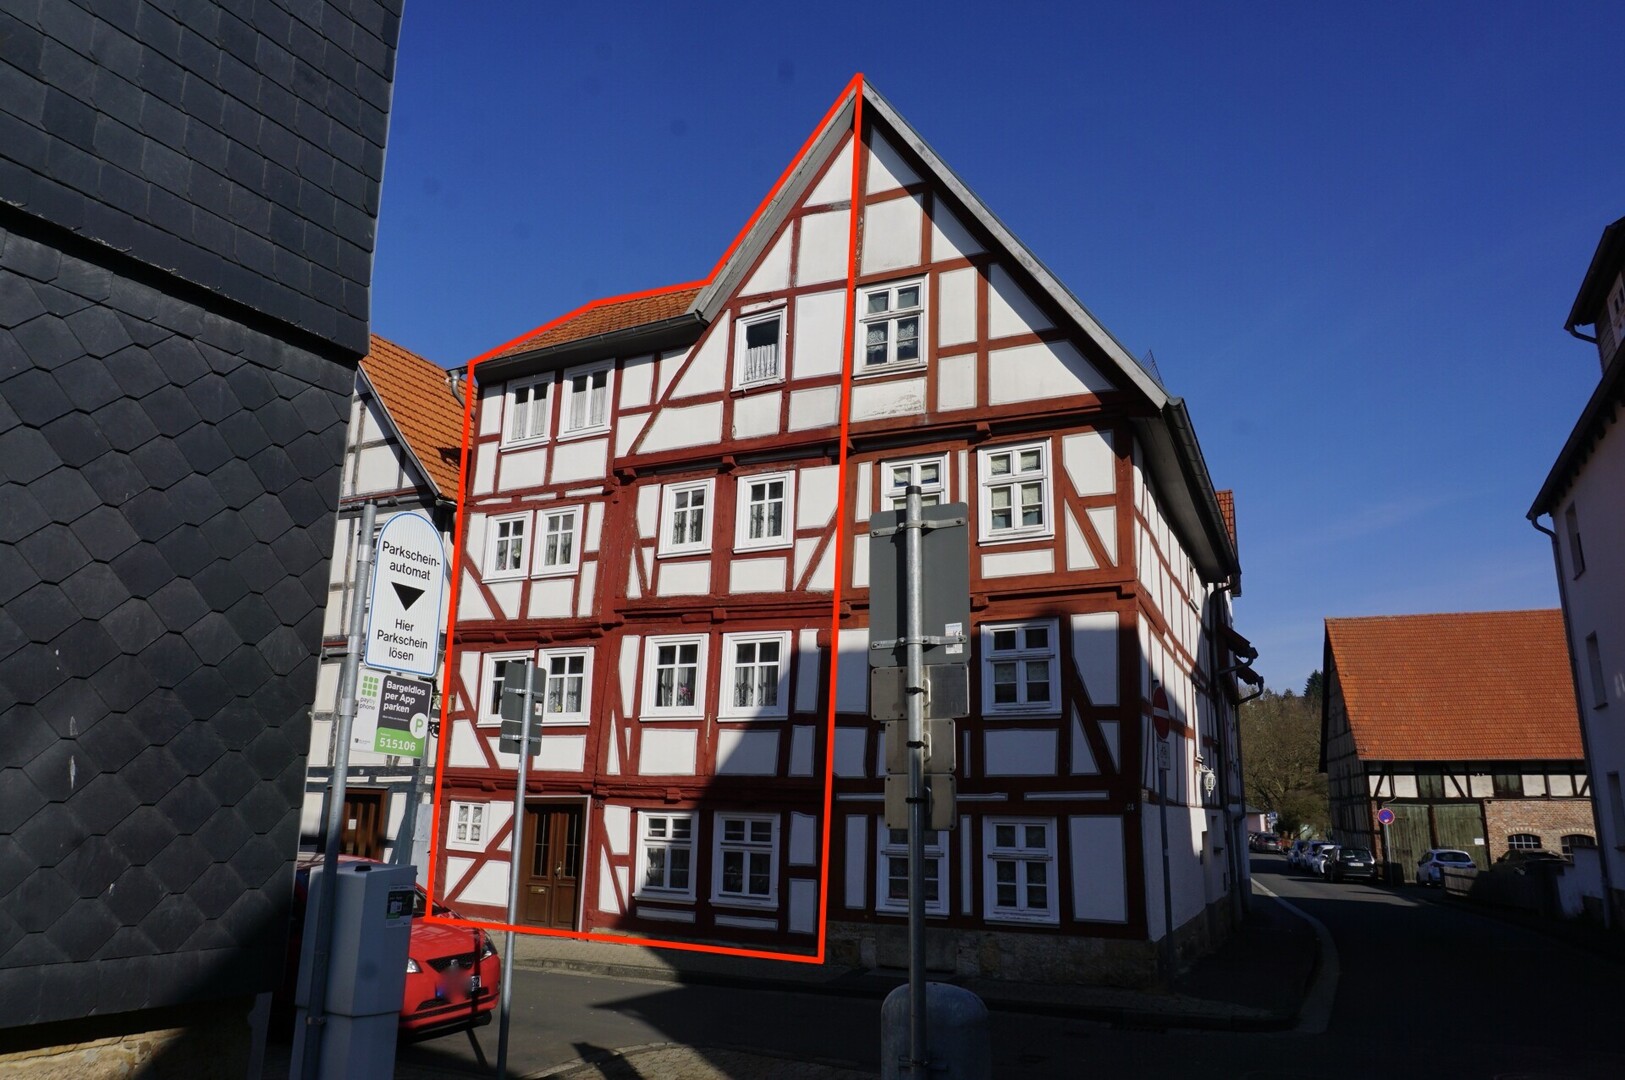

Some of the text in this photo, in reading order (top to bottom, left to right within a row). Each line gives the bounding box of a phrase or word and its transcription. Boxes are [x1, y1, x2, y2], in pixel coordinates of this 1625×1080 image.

[382, 540, 441, 567] Parkschein-
[389, 561, 431, 581] automat
[395, 618, 415, 632] Hier
[377, 629, 428, 649] Parkschein
[389, 646, 414, 661] lösen
[386, 680, 426, 696] Bargeldlos
[384, 692, 416, 704] per App
[383, 703, 410, 713] parken
[380, 737, 416, 751] 515106
